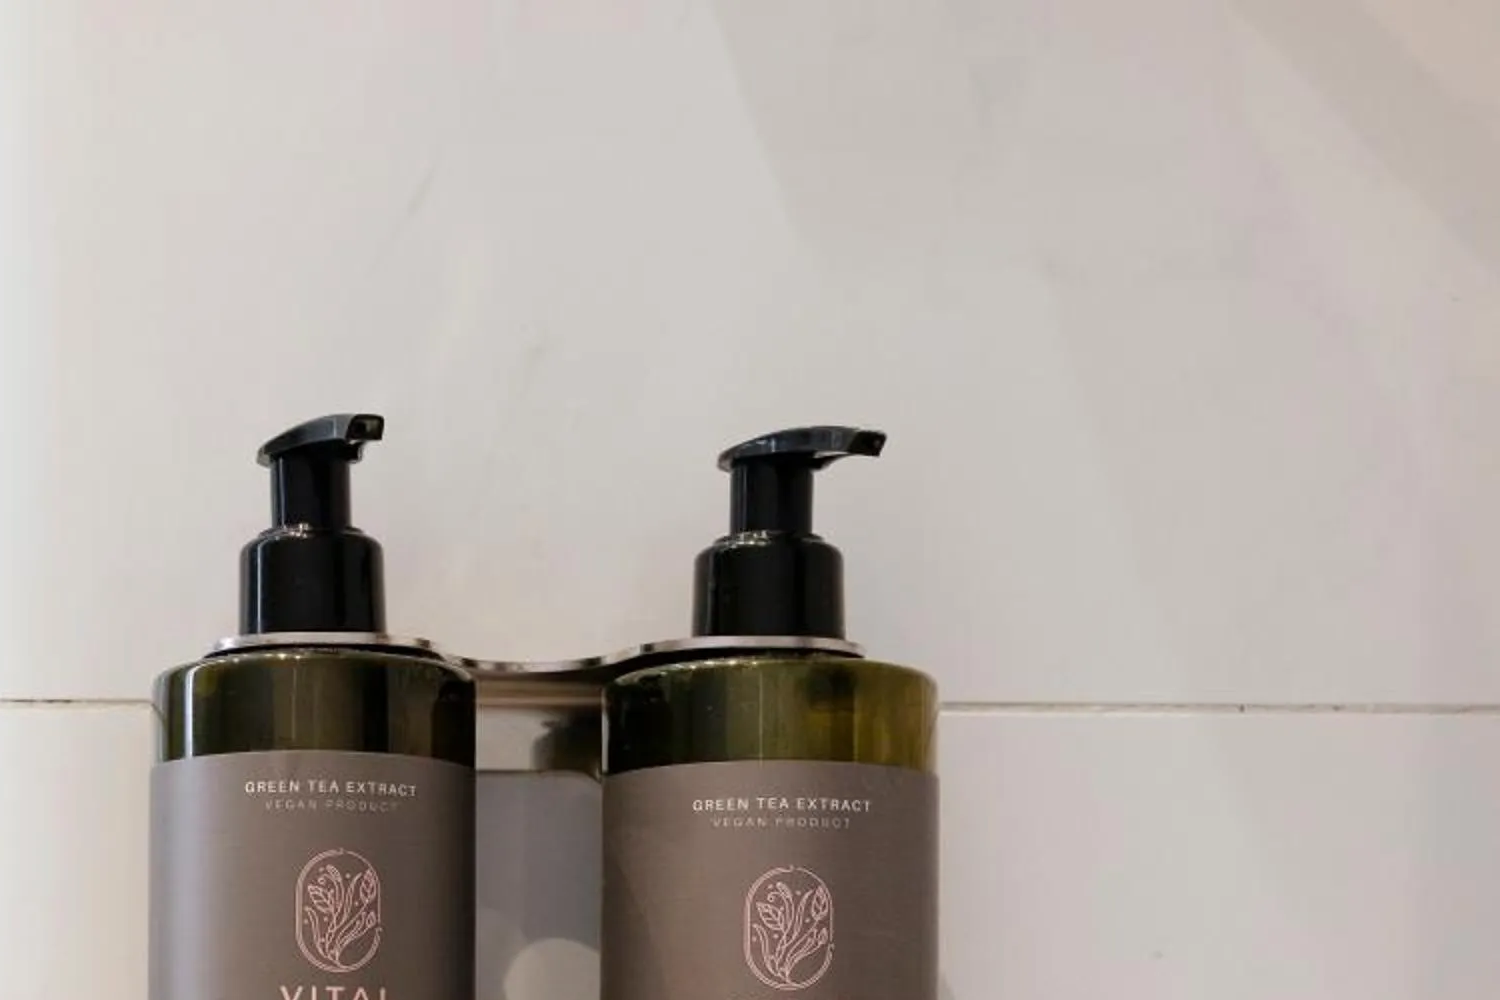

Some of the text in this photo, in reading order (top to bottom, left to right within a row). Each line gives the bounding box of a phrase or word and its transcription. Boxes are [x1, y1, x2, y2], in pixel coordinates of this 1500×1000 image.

[244, 779, 418, 797] GREEN TEA EXTRACT
[265, 799, 318, 811] VEGAN
[692, 796, 871, 813] GREEN TEA EXTRACT
[711, 816, 767, 828] VEGAN
